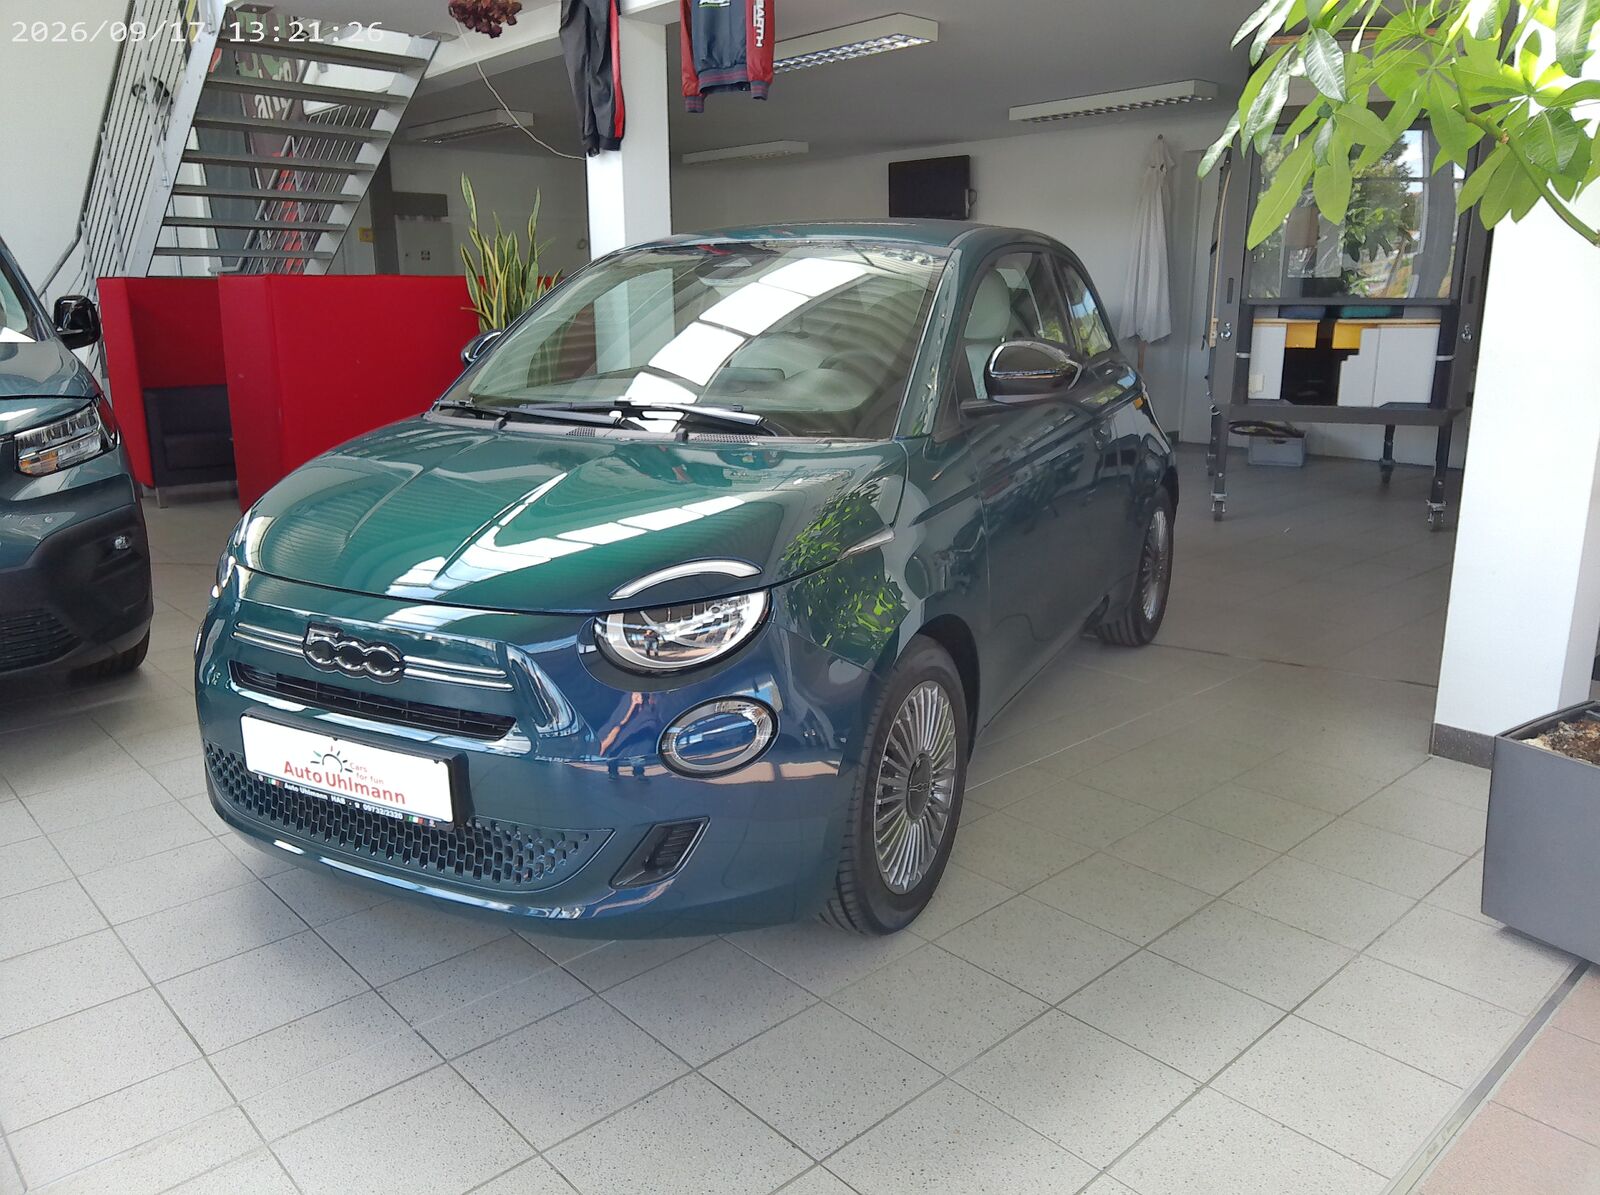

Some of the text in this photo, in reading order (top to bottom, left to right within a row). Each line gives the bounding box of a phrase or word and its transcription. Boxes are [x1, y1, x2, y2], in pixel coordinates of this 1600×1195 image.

[303, 622, 404, 684] 500
[349, 762, 368, 773] Cars
[284, 760, 406, 805] Auto Uhlmann
[356, 772, 384, 785] for fun
[284, 782, 299, 793] Auto
[299, 786, 328, 801] Uhlmann
